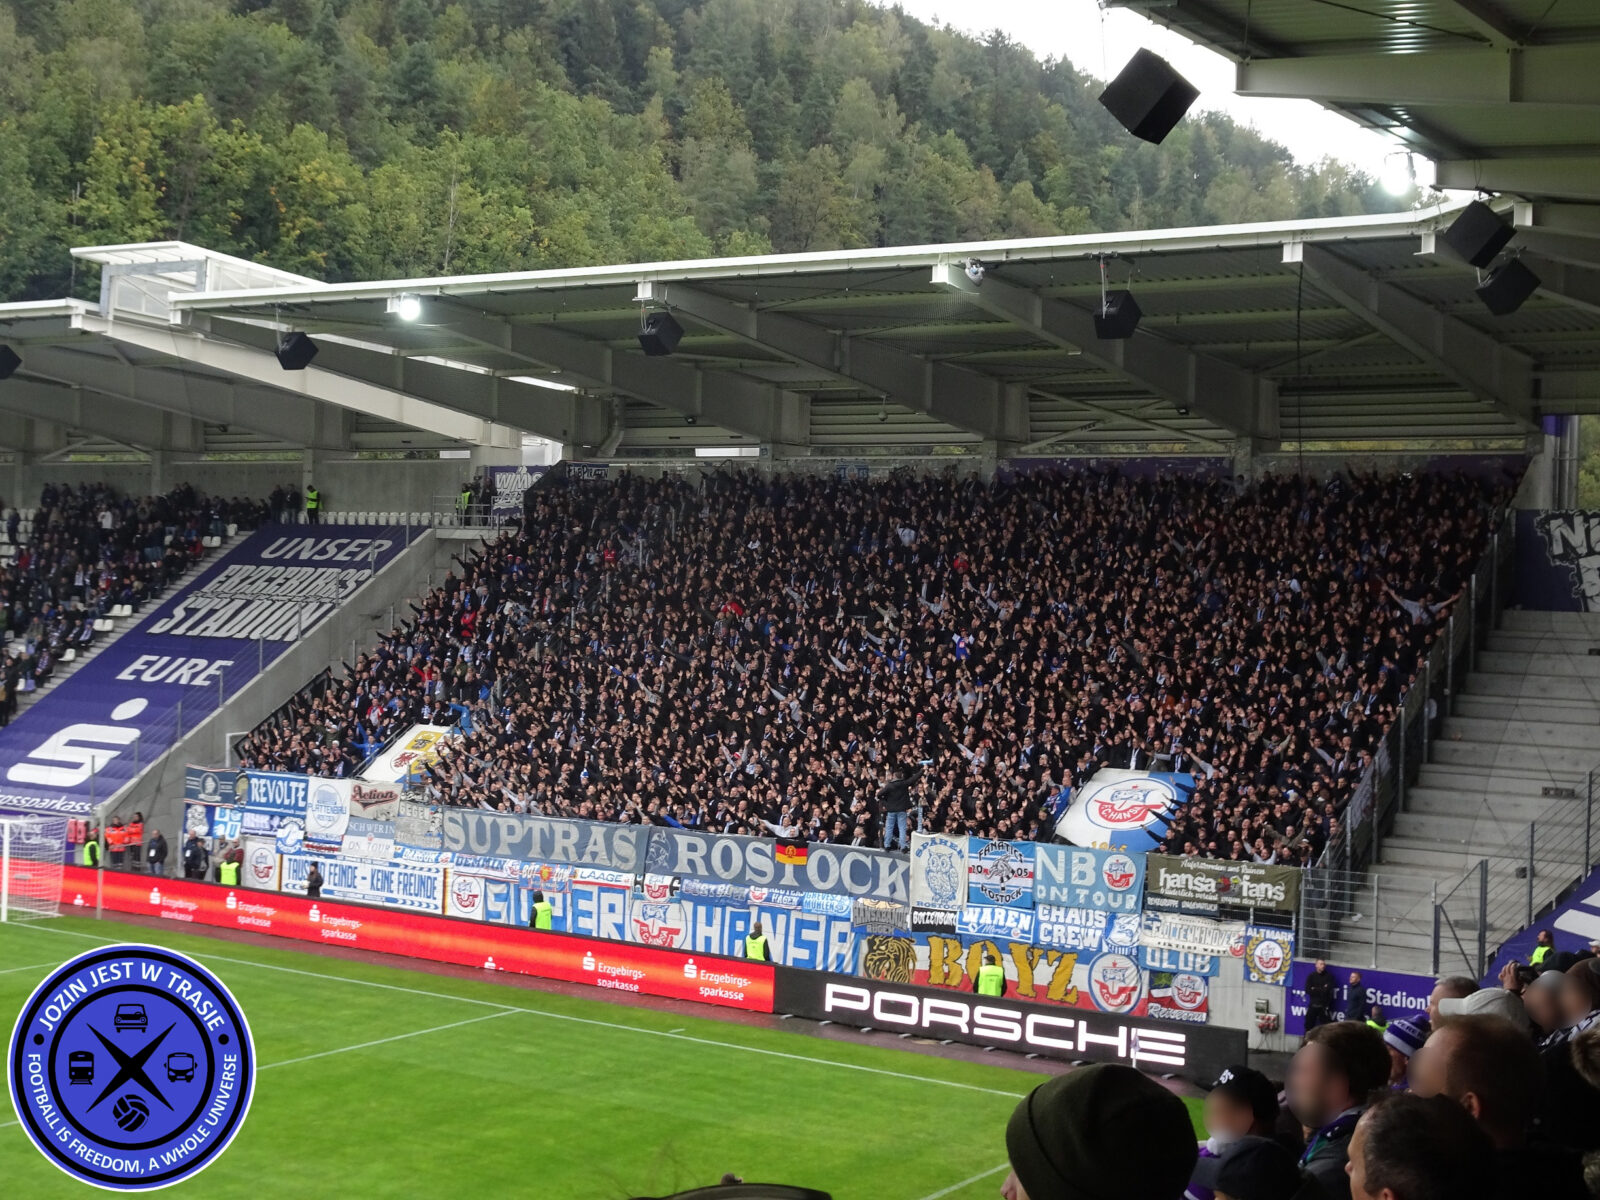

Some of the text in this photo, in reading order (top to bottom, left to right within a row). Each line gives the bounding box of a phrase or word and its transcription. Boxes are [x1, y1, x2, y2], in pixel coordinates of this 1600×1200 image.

[261, 537, 392, 562] UNSER
[147, 596, 336, 642] STADION
[116, 654, 234, 686] EURE
[250, 777, 307, 807] REVOLTE
[351, 784, 398, 801] Action
[348, 821, 395, 835] SCHWERIN
[444, 810, 638, 870] SUPTRAS
[978, 841, 1024, 863] FANATICS
[579, 869, 623, 883] LAAGE
[1036, 846, 1096, 887] NB
[327, 863, 357, 889] FEINDE
[370, 868, 395, 893] KEINE
[397, 871, 438, 900] FREUNDE
[981, 883, 1022, 903] ROSTOCK
[1159, 867, 1286, 902] hansa fans
[1036, 884, 1068, 902] ON
[1075, 888, 1137, 910] TOUR
[237, 914, 271, 928] sparkasse
[321, 913, 363, 930] Erzgebirgs-
[962, 906, 1032, 931] WAREN
[1038, 903, 1107, 929] CHAOS
[320, 926, 357, 941] sparkasse
[1040, 922, 1102, 950] CREW
[1246, 927, 1295, 942] ALTMARK
[598, 962, 646, 980] Erzgebirgs-
[700, 969, 752, 988] Erzgebirgs-
[927, 935, 1079, 1005] BOYZ
[597, 976, 639, 992] sparkasse
[699, 985, 744, 1001] sparkasse
[824, 982, 1186, 1066] PORSCHE
